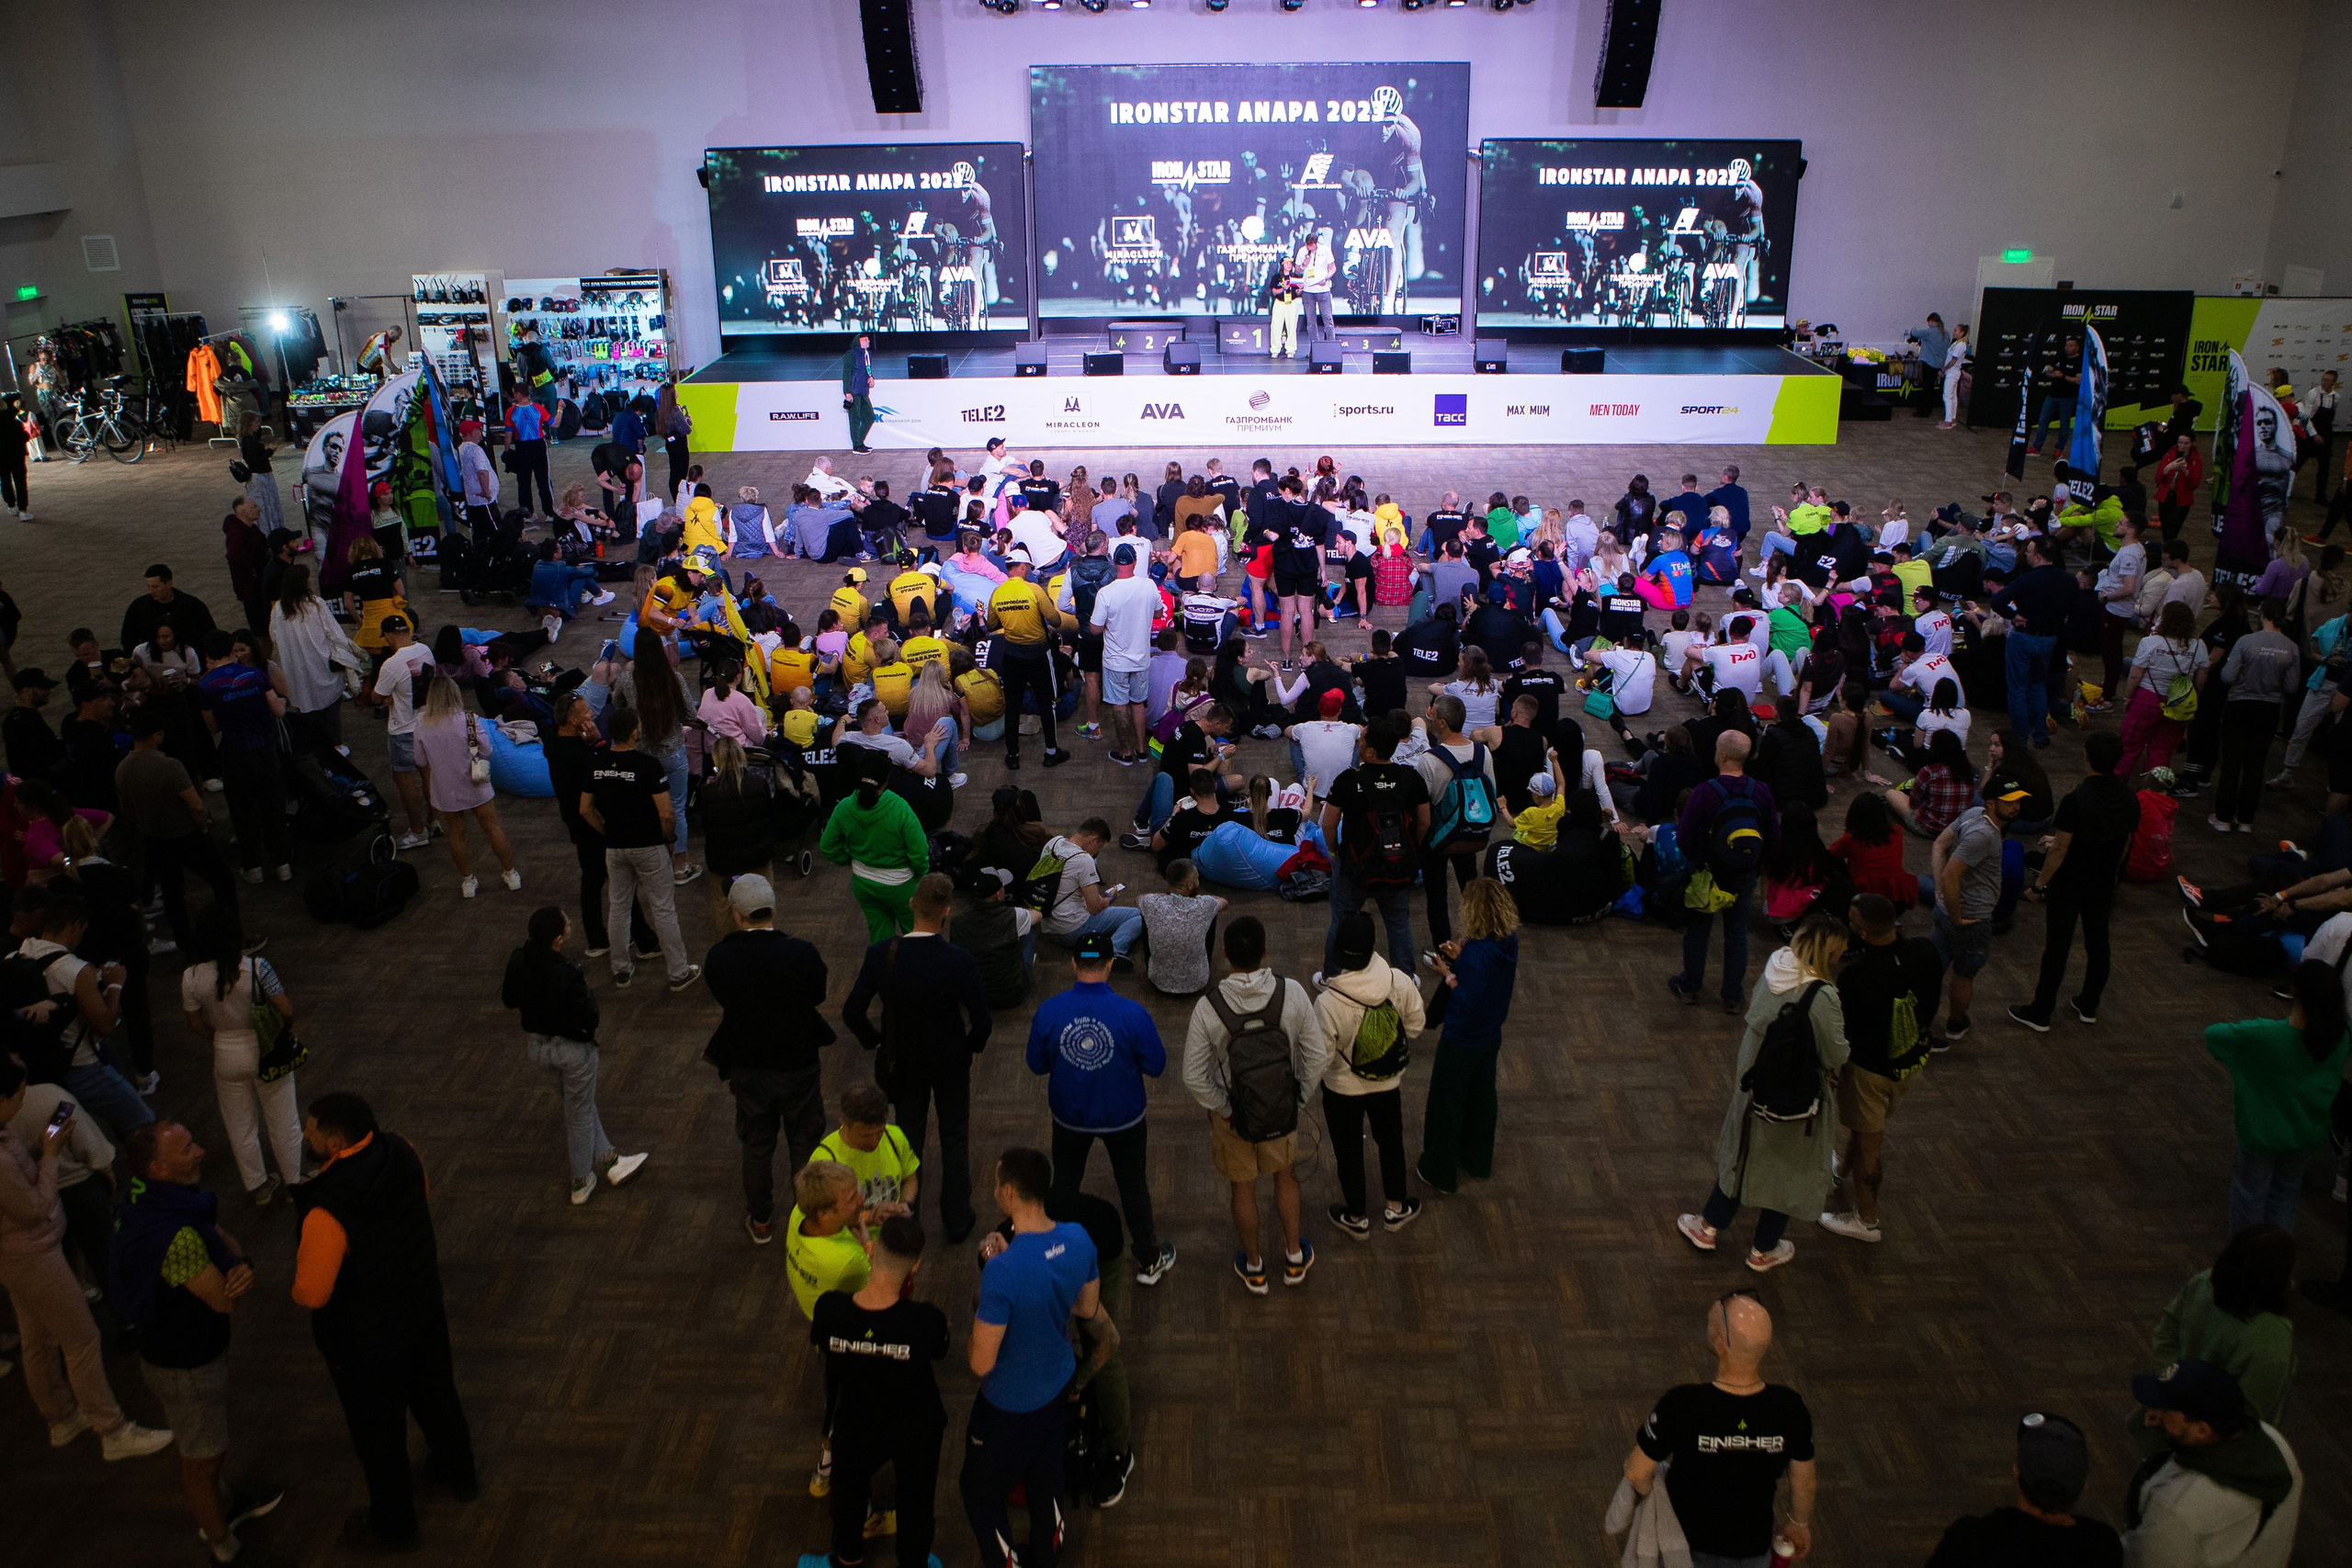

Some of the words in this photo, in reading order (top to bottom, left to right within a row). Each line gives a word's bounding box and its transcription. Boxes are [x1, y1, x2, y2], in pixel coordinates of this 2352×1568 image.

[1110, 101, 1230, 125] IRONSTAR
[1237, 100, 1319, 123] ANAPA
[1151, 160, 1183, 178] IRON
[1197, 160, 1231, 178] STAR
[763, 175, 851, 193] IRONSTAR
[855, 173, 916, 191] ANAPA
[1539, 168, 1626, 186] IRONSTAR
[1631, 168, 1690, 186] ANAPA
[796, 218, 820, 232] IRON
[829, 217, 854, 231] STAR
[1566, 211, 1590, 226] IRON
[1600, 211, 1625, 225] STAR
[1343, 228, 1395, 249] AVA
[1104, 250, 1163, 259] MIRACLEON
[1216, 244, 1288, 254] ГАЗПРОМБАНК
[1228, 254, 1277, 264] ПРЕМИУМ
[939, 265, 977, 282] AVA
[1702, 263, 1739, 279] AVA
[2063, 304, 2086, 316] IRON
[2094, 304, 2119, 317] STAR
[1146, 336, 1155, 350] 2
[1252, 328, 1262, 349] 1
[1363, 339, 1369, 349] 3
[2194, 340, 2220, 354] IRON
[2191, 355, 2228, 371] STAR
[961, 404, 1006, 423] TELE2
[1140, 403, 1185, 419] AVA
[1339, 404, 1394, 416] sports.ru
[1589, 404, 1611, 416] MEN
[1611, 404, 1641, 416] TODAY
[1680, 406, 1738, 414] SPORT24
[1611, 597, 1641, 607] IRONSTAR
[1413, 648, 1439, 661] TELE2
[1396, 745, 1424, 762] FINISHER
[594, 770, 635, 781] FINISHER
[1497, 846, 1515, 885] TELE2
[830, 1336, 910, 1358] FINISHER
[1698, 1435, 1785, 1449] FINISHER
